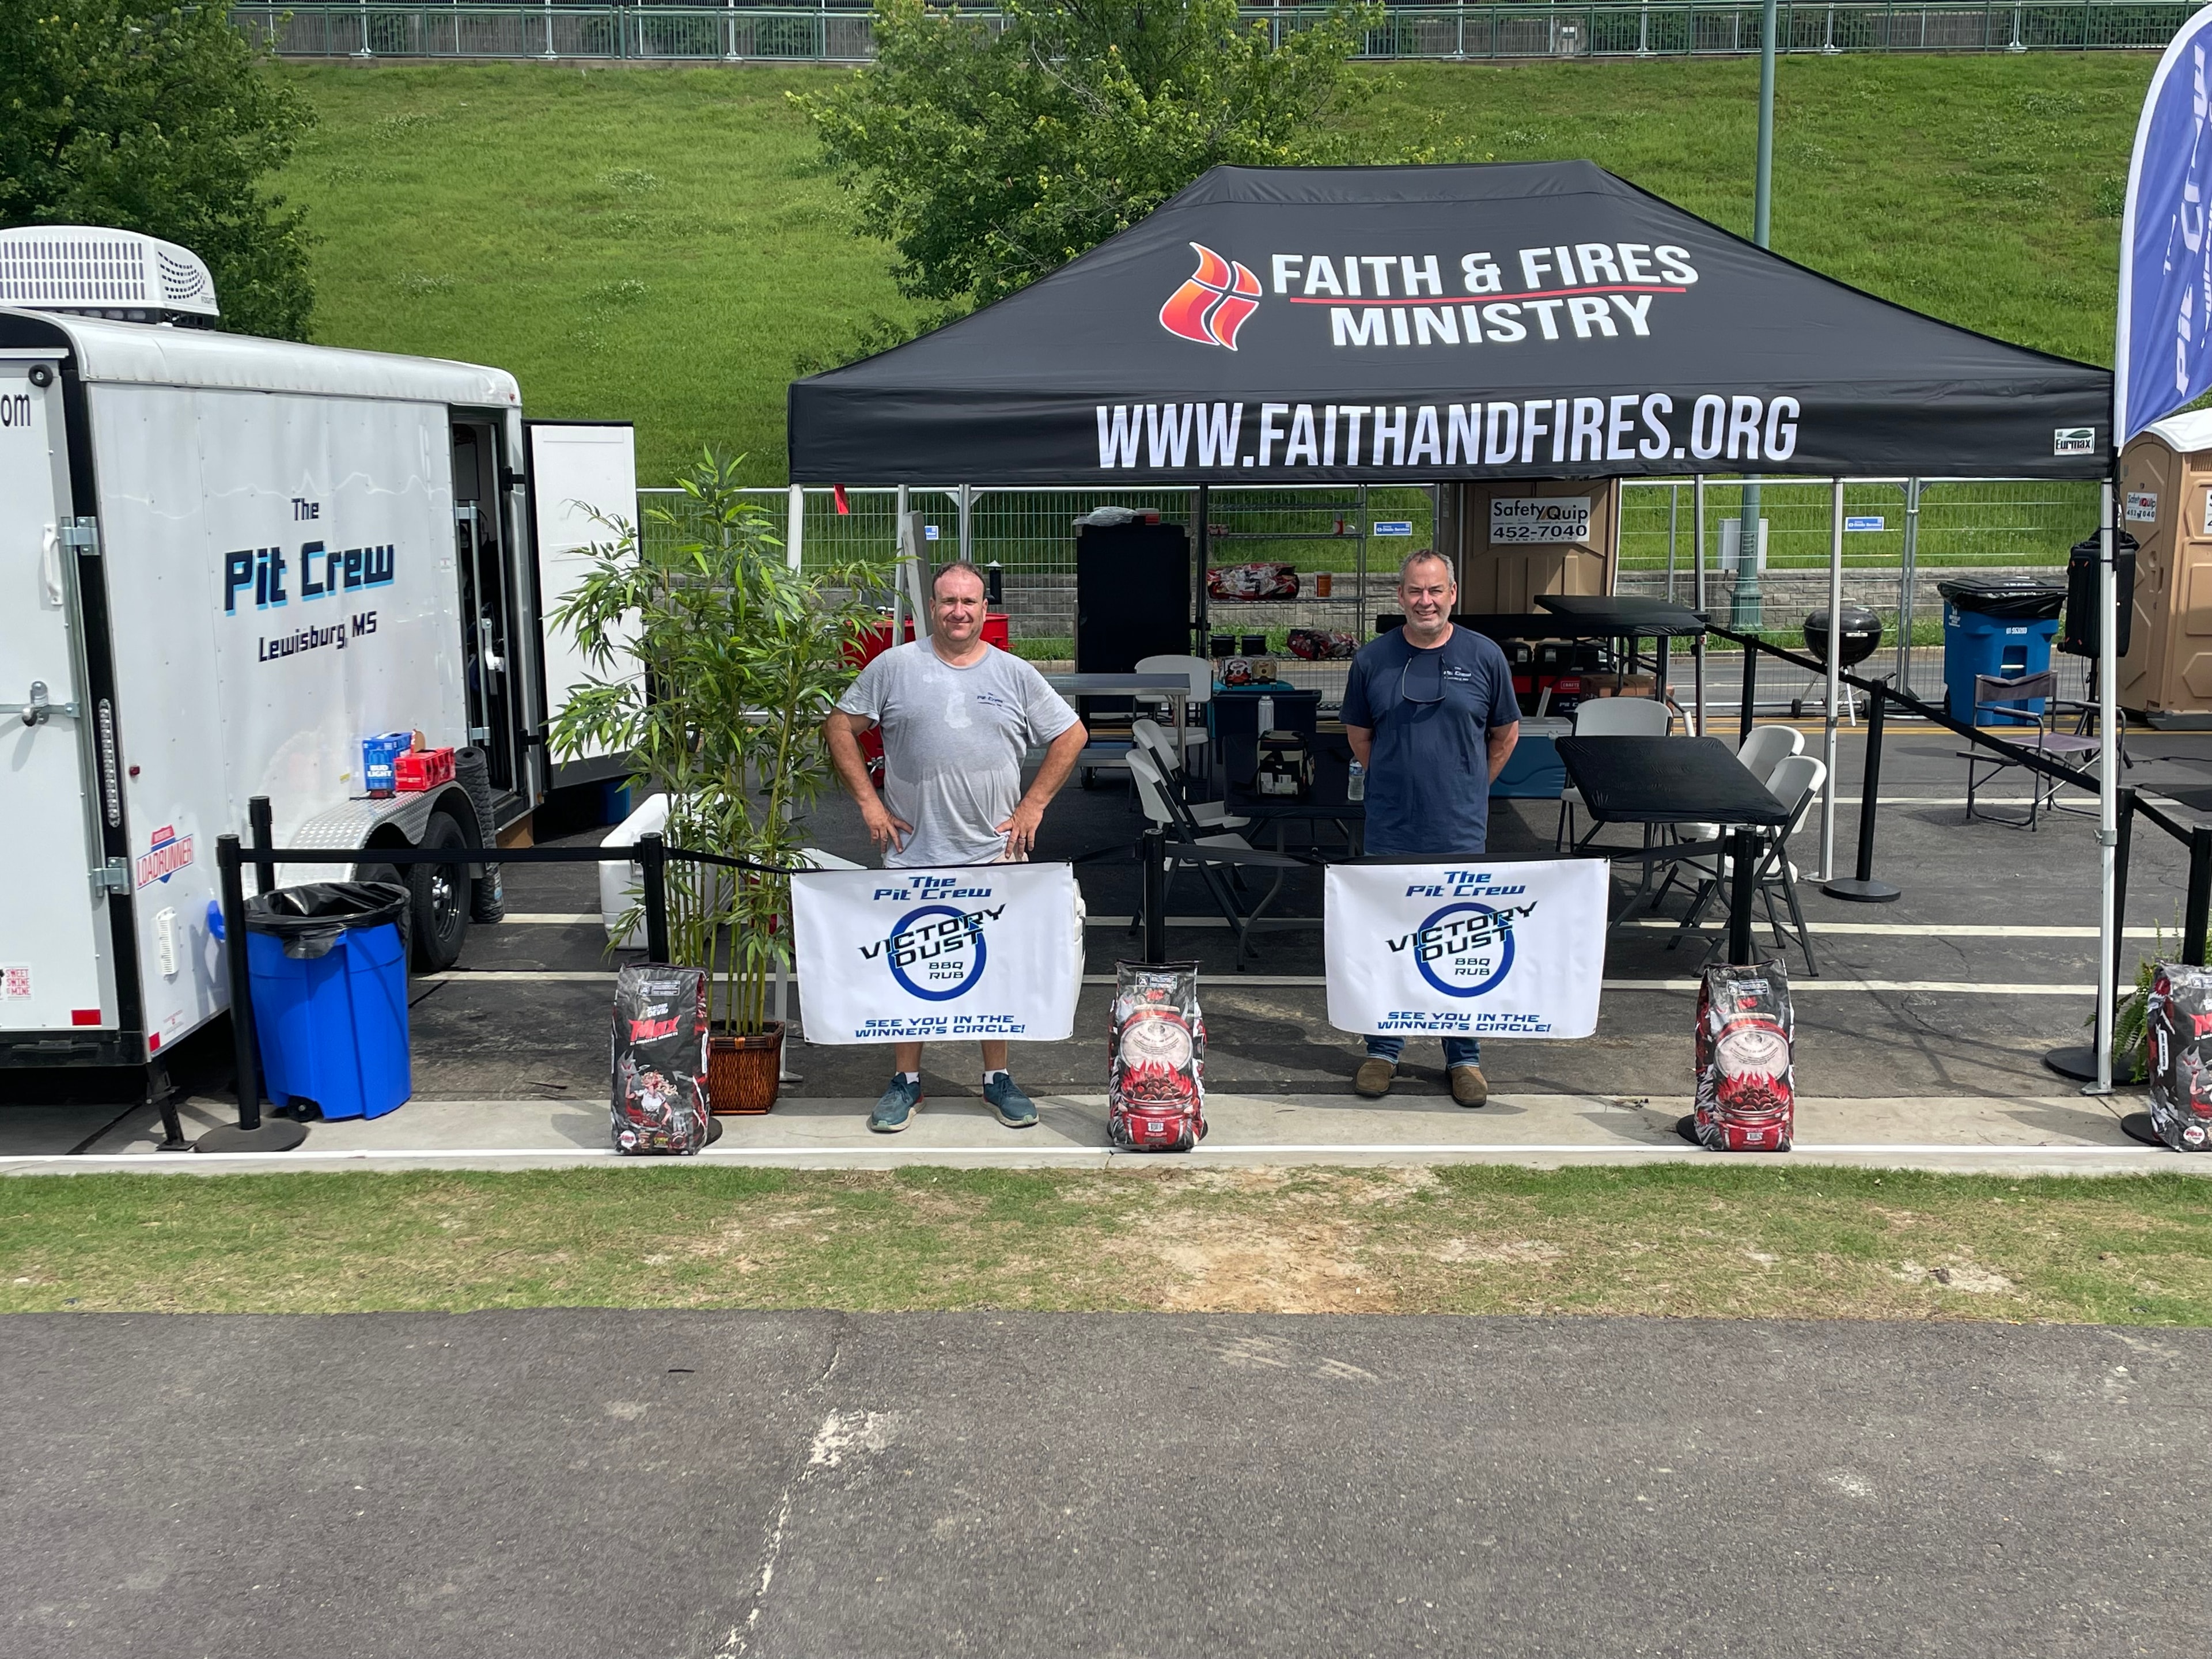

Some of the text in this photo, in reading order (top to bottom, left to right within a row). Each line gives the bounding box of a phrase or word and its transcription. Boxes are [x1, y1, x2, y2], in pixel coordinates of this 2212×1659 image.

[1271, 243, 1699, 297] FAITH & FIRES
[1330, 294, 1653, 347] MINISTRY
[1095, 393, 1801, 468] WWW.FAITHANDFIRES.ORG
[2055, 438, 2091, 449] Eurmax
[291, 498, 319, 521] The
[1493, 525, 1587, 537] 452-7040
[224, 540, 395, 617] Pit Crew
[352, 611, 377, 637] MS
[137, 836, 193, 887] LOADRUNNER
[908, 876, 956, 888] The
[1444, 870, 1491, 884] The
[873, 888, 992, 901] Pit Crew
[1405, 884, 1527, 897] Pit Crew
[858, 903, 1007, 960] VICTORY
[1385, 899, 1539, 953] VICTORY
[891, 928, 983, 968] DUST
[1418, 925, 1513, 963] DUST
[928, 961, 964, 970] BBQ
[1455, 957, 1491, 967] BBQ
[929, 971, 964, 980] RUB
[1455, 968, 1490, 976] RUB
[865, 1014, 1014, 1028] SEE YOU IN THE
[1387, 1012, 1540, 1022] SEE YOU IN THE
[855, 1024, 1025, 1037] WINNER'S CIRCLE!
[1377, 1021, 1552, 1032] WINNER'S CIRCLE!
